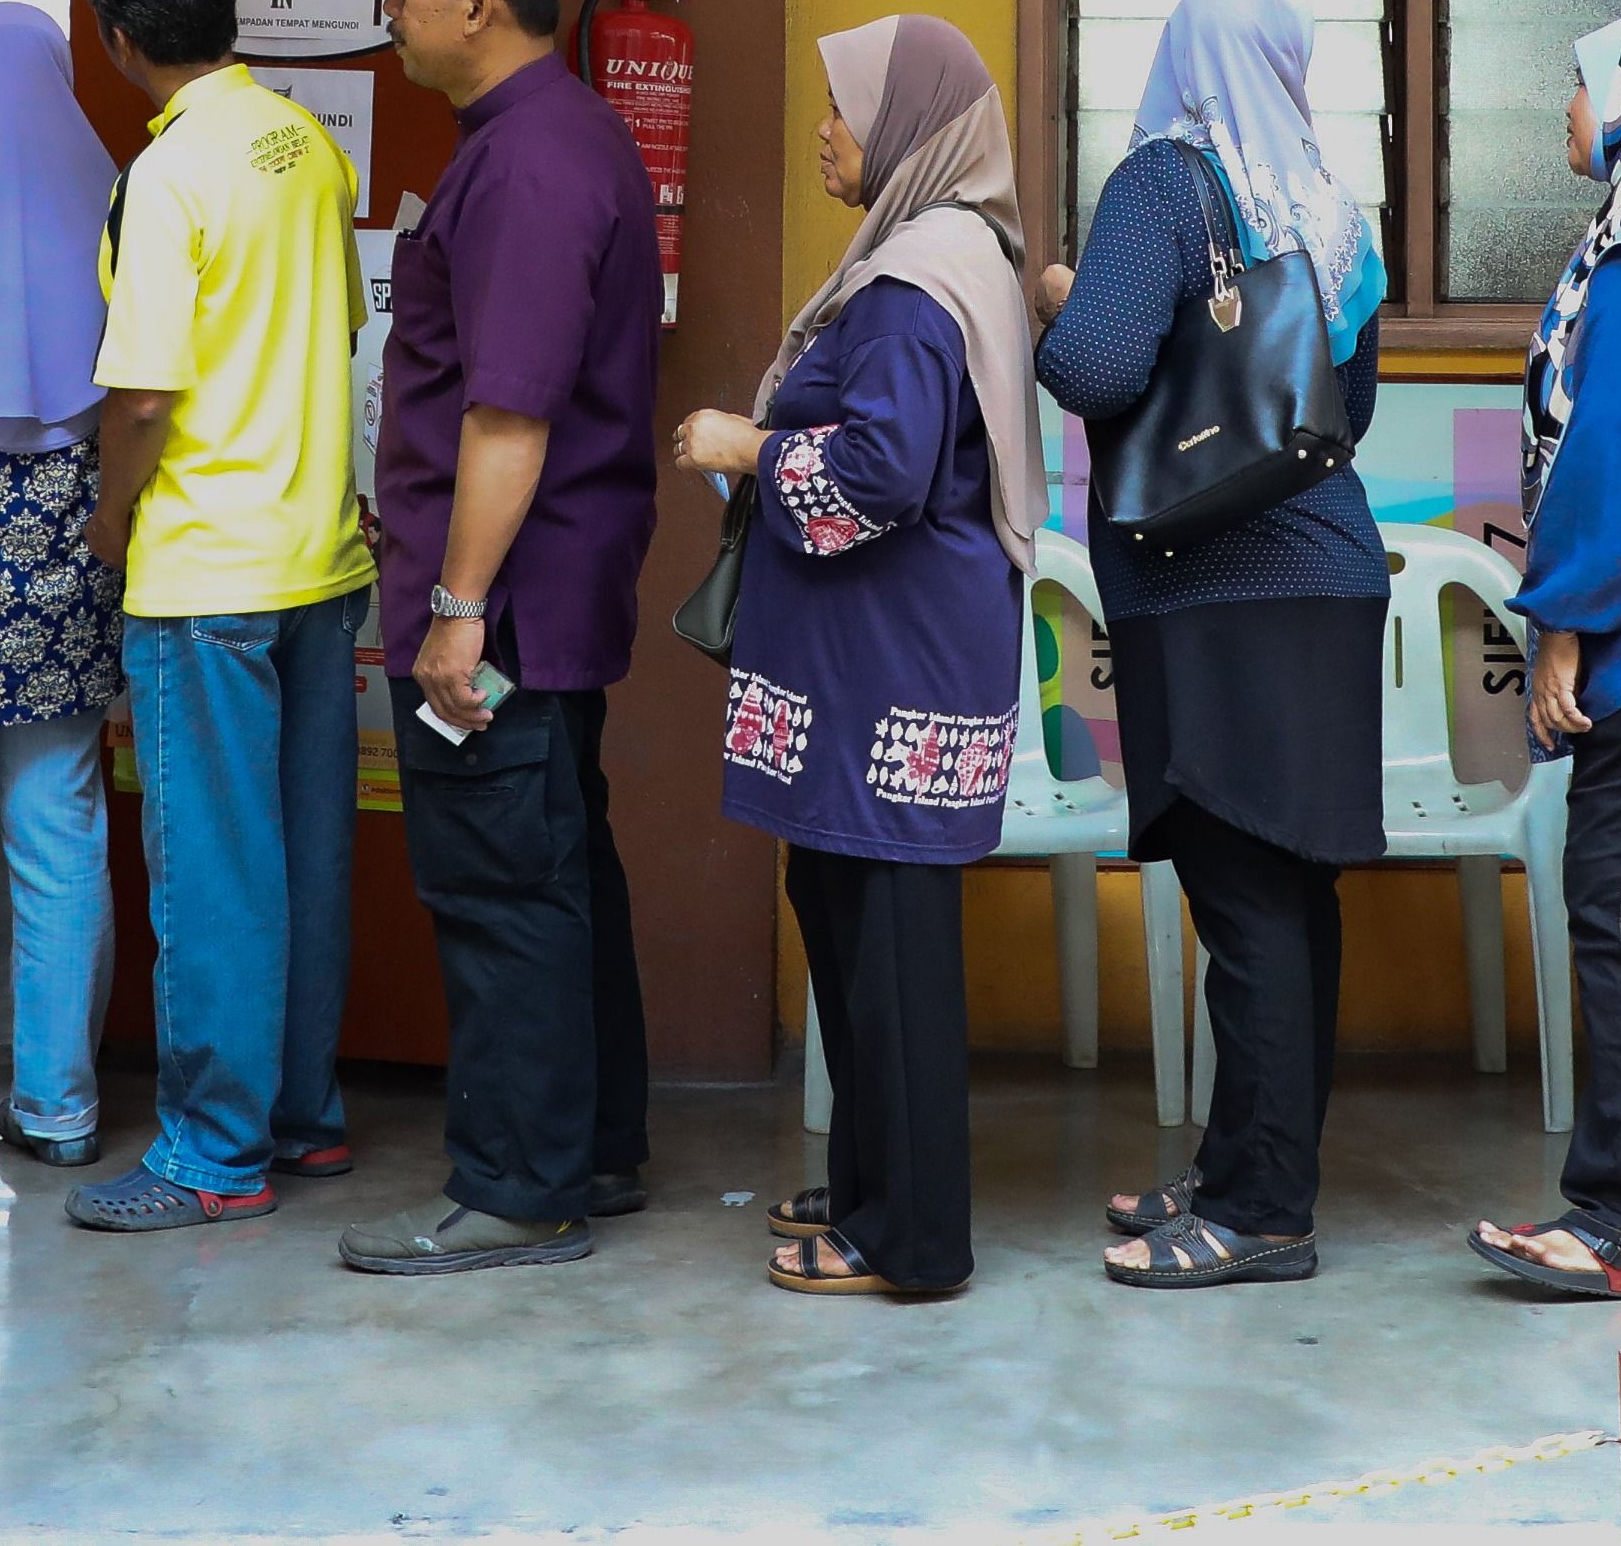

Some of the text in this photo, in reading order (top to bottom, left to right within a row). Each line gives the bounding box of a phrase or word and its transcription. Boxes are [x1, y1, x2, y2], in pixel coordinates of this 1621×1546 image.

[276, 19, 310, 28] TEMPAT
[312, 20, 359, 30] MENGUNDI
[606, 59, 694, 84] UNIQUE
[607, 81, 632, 90] FIRE
